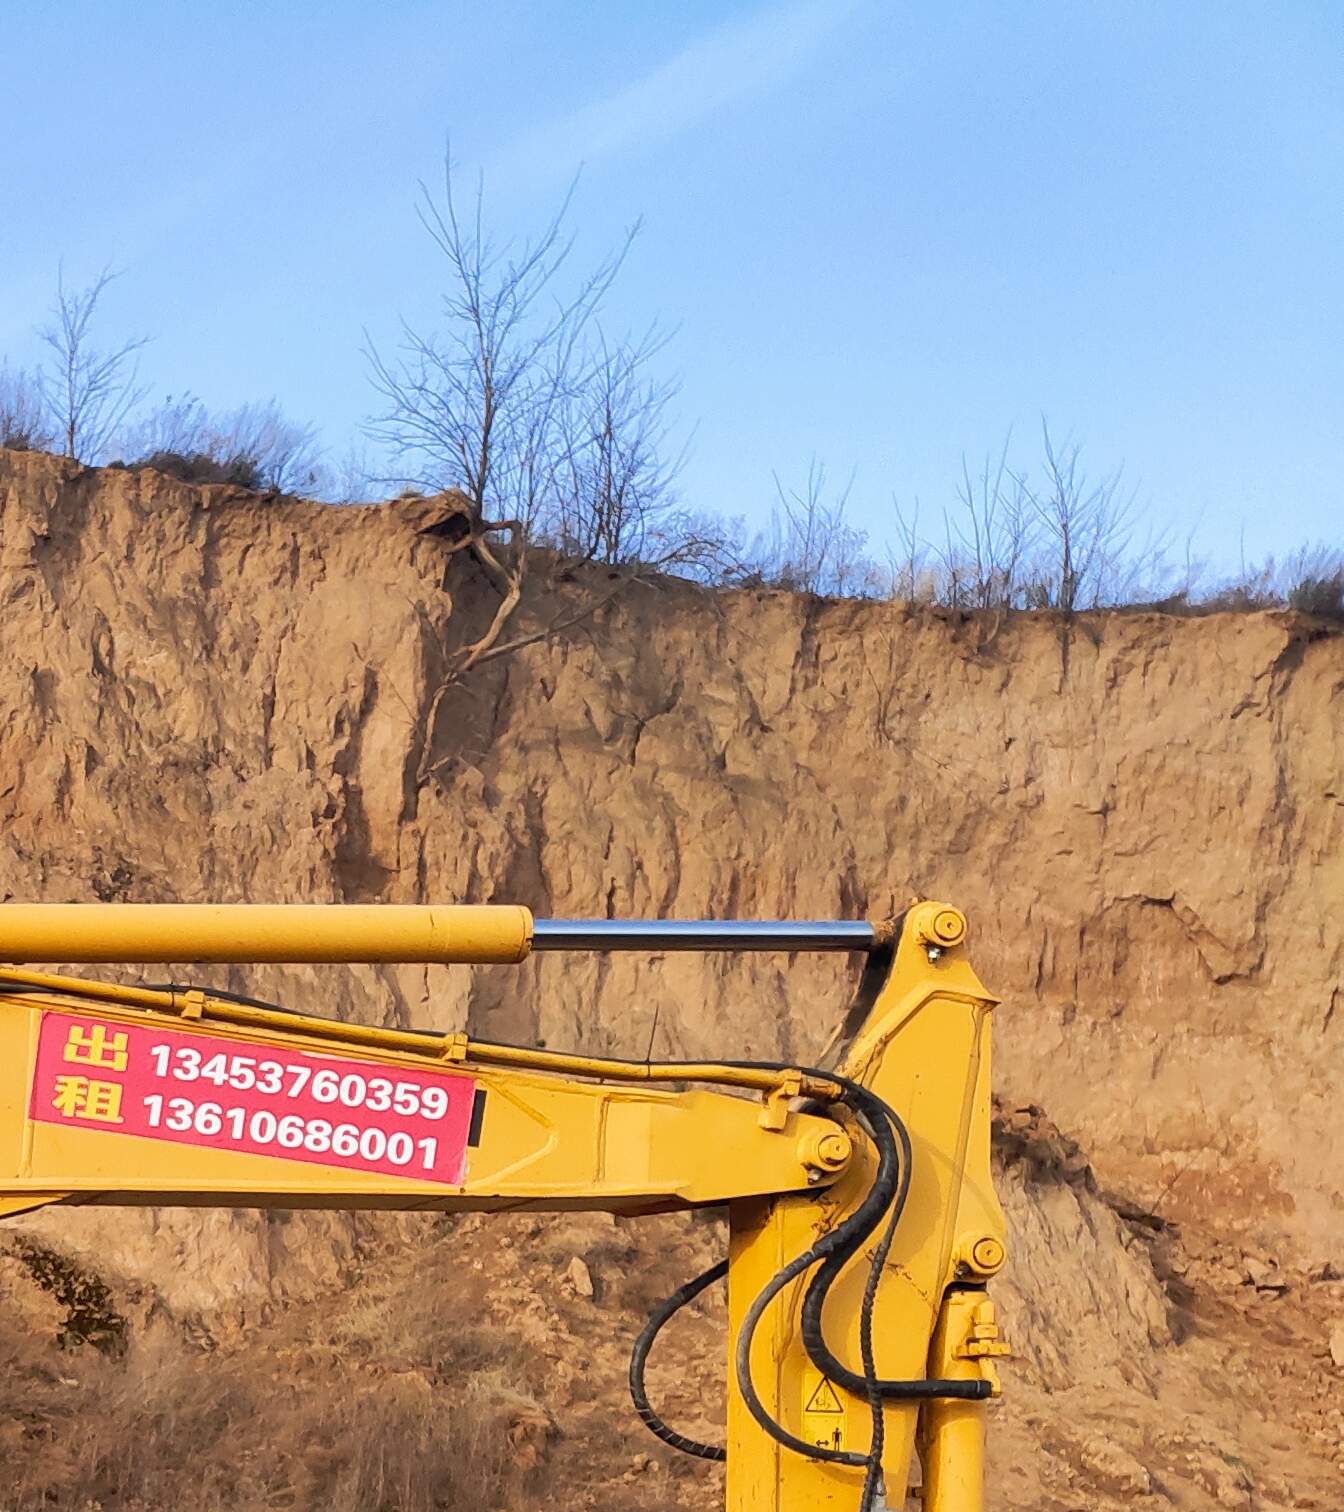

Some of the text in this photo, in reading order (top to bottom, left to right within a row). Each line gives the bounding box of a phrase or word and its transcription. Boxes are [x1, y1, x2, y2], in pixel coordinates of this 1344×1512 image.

[52, 1024, 129, 1124] 出租
[151, 1044, 448, 1120] 13453760359
[143, 1095, 437, 1169] 13610686001
